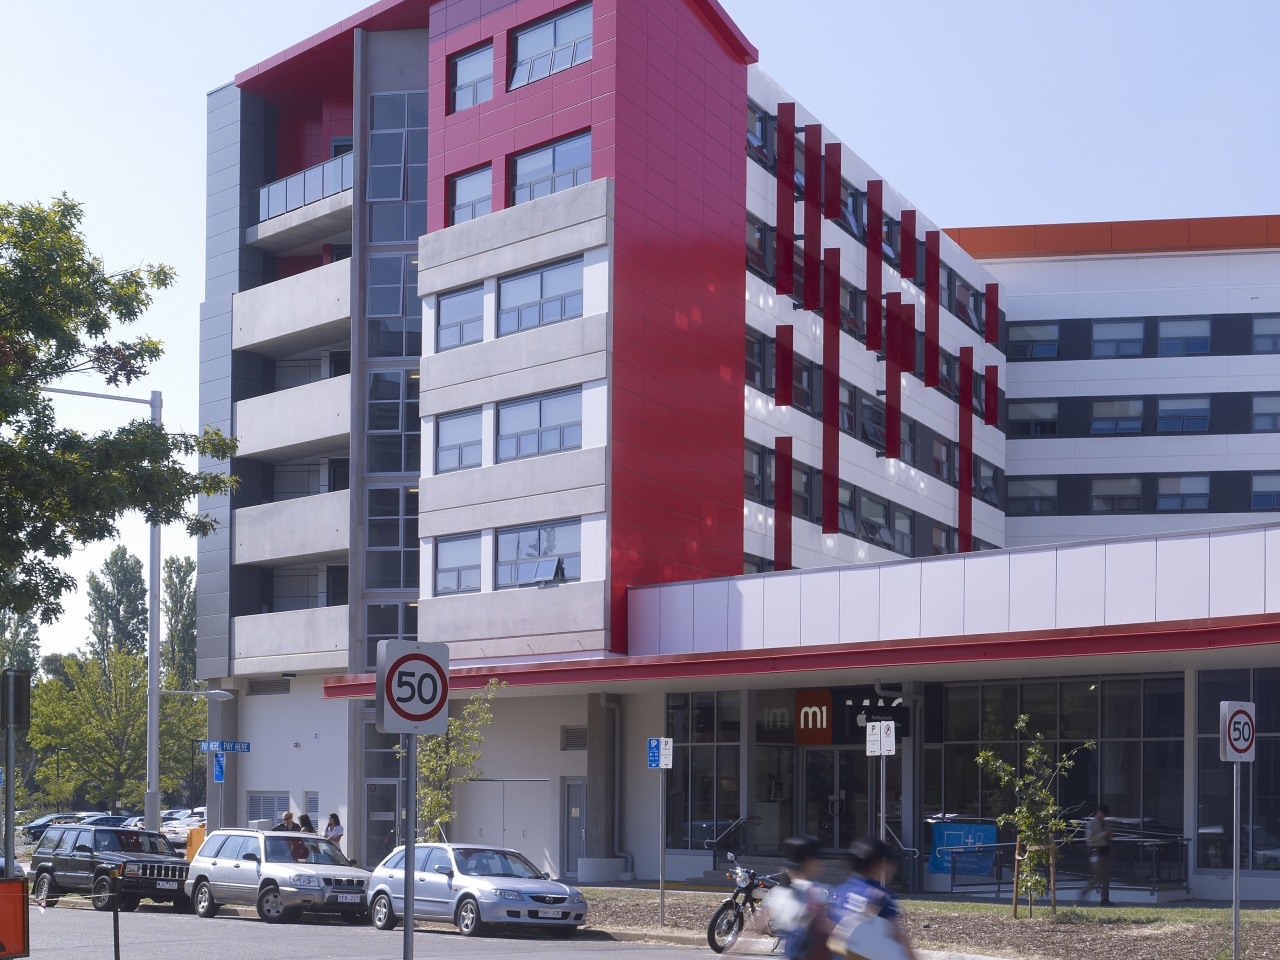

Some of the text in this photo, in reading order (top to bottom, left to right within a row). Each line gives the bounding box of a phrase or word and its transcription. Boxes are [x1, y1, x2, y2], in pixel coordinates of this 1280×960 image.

[395, 670, 438, 705] 50
[871, 724, 876, 732] P
[1232, 720, 1251, 742] 50
[223, 742, 249, 752] PAY HERE
[664, 740, 669, 748] P
